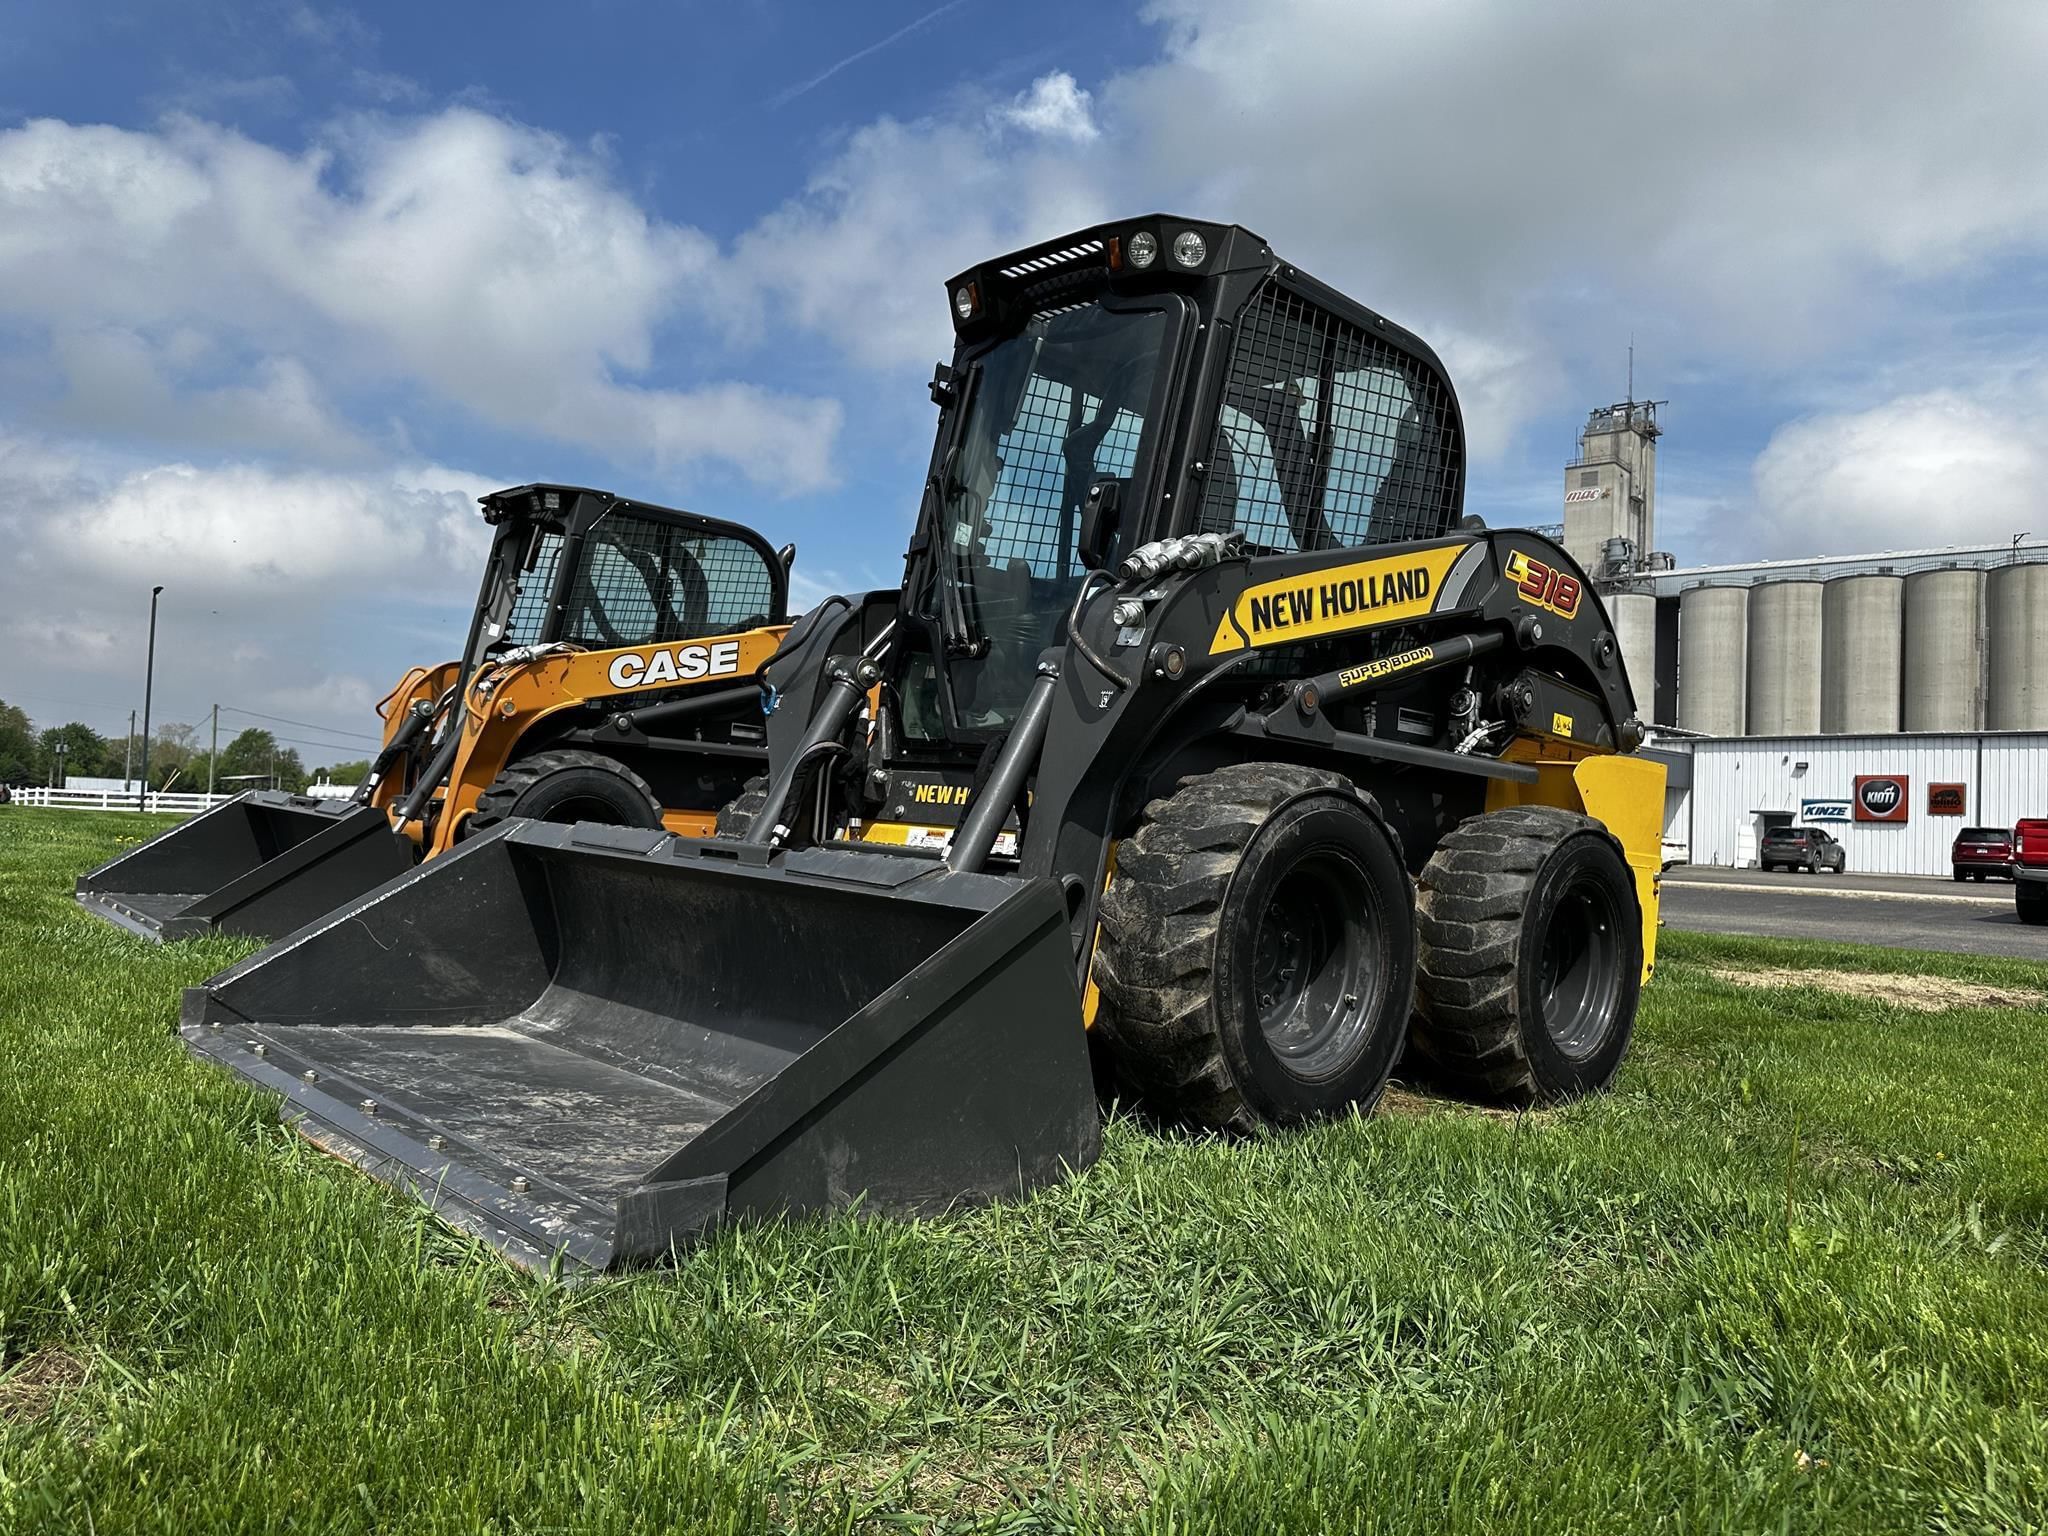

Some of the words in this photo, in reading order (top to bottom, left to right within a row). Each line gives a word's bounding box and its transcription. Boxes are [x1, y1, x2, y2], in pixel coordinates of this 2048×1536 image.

[1250, 586, 1313, 633] NEW
[1319, 567, 1430, 619] HOLLAND
[1505, 551, 1581, 617] L318
[608, 640, 739, 689] CASE
[1340, 660, 1390, 686] SUPER
[1391, 647, 1432, 669] BOOM
[915, 784, 953, 804] NEW
[1804, 806, 1848, 816] KINZE
[1866, 787, 1895, 804] KIOTI
